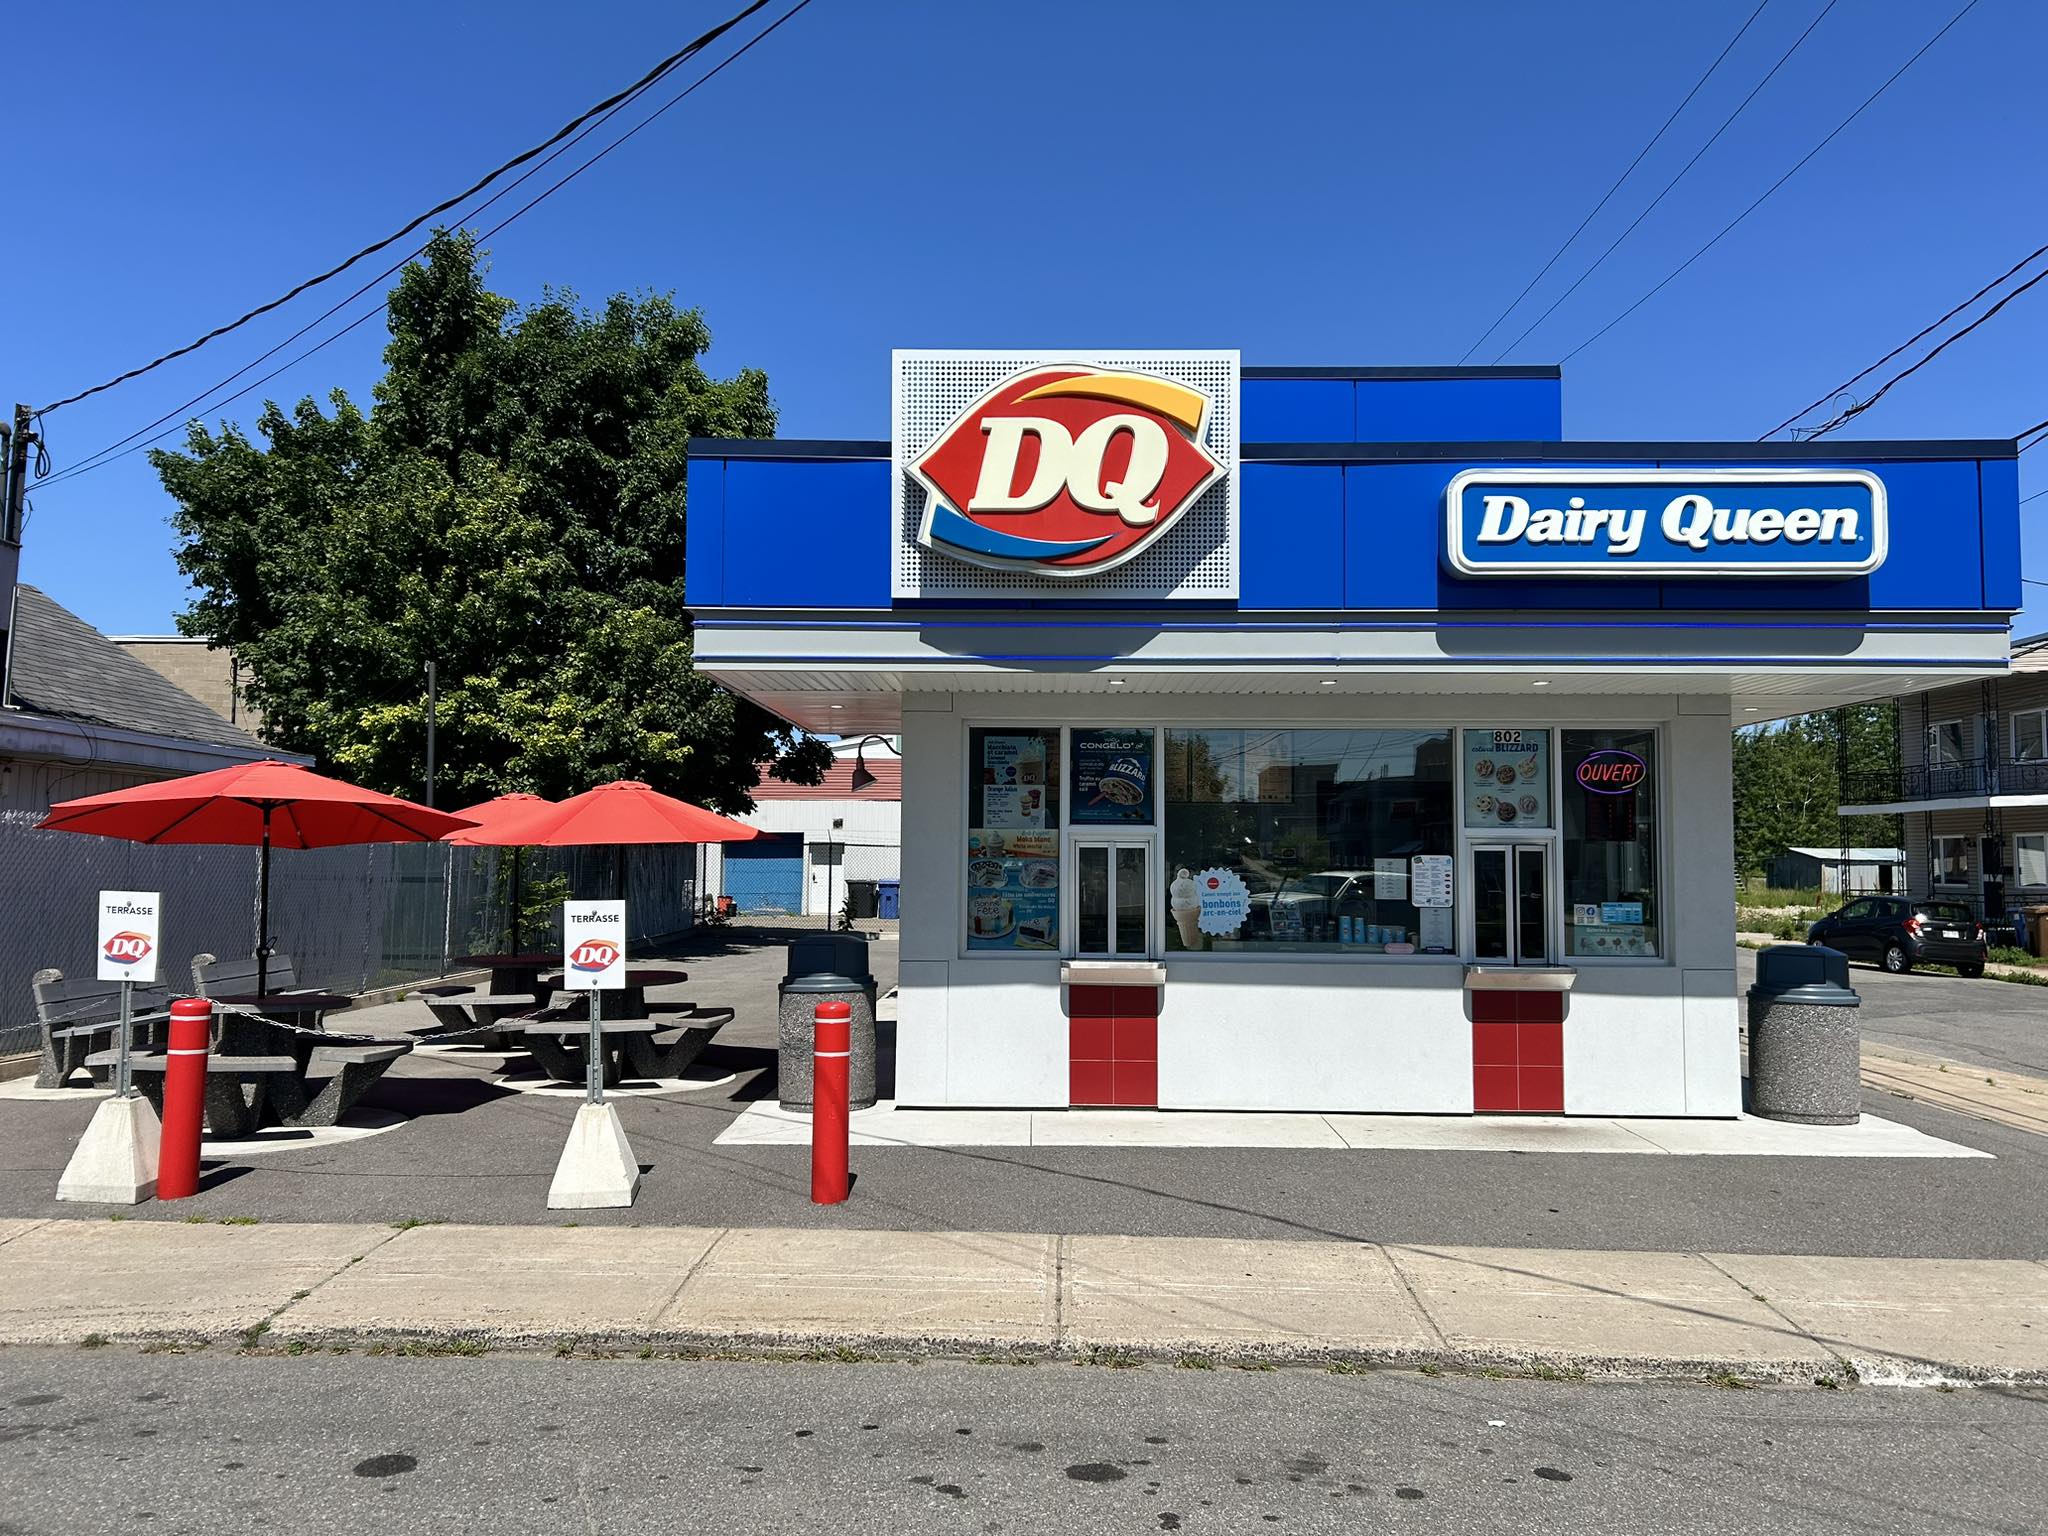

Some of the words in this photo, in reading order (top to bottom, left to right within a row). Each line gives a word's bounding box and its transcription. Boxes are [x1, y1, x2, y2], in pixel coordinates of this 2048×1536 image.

[967, 413, 1170, 526] DQ
[1476, 494, 1647, 554] Dairy
[1660, 494, 1862, 550] Queen
[1494, 731, 1521, 743] 802
[1495, 743, 1539, 753] BLIZZARD
[1108, 762, 1146, 781] BLIZZARD
[1580, 763, 1642, 782] OUVERT
[105, 905, 153, 915] TERRASSE
[1202, 899, 1242, 909] bonbons
[570, 914, 620, 923] TERRASSE
[110, 938, 146, 959] DQ
[577, 946, 614, 966] DQ
